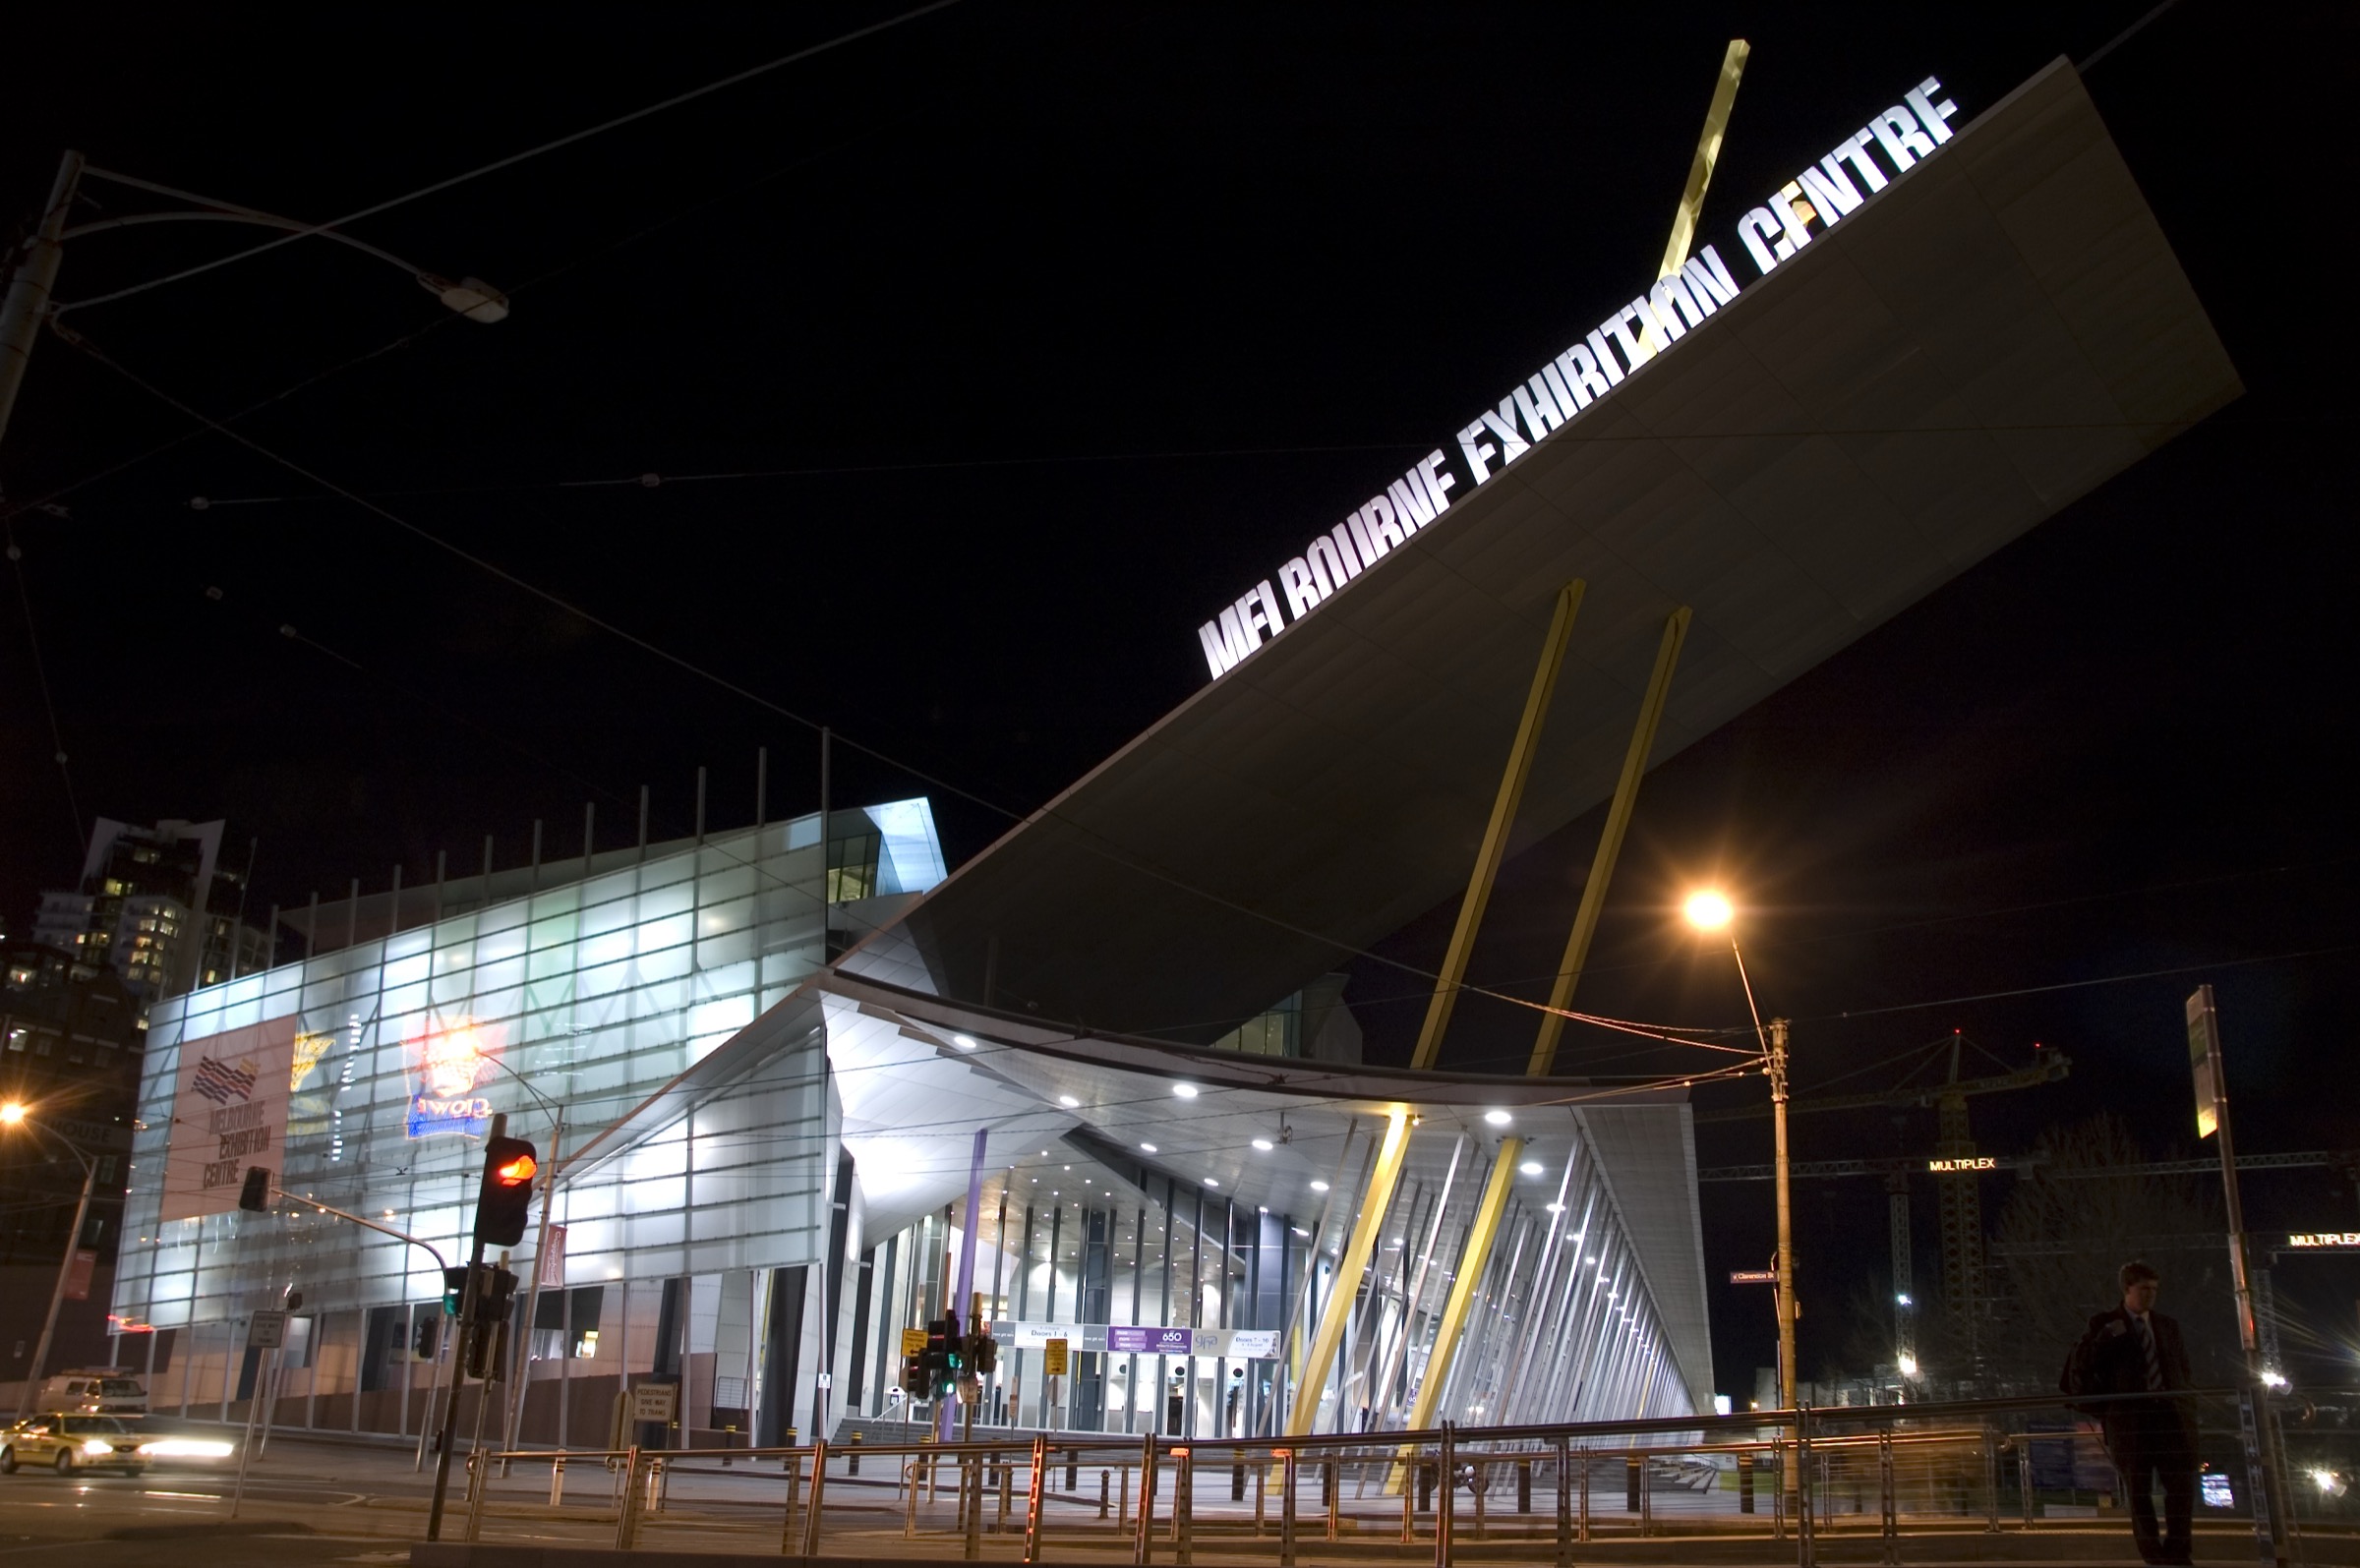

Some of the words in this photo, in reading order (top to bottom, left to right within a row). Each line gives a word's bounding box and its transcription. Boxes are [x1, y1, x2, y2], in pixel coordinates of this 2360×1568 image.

[1455, 244, 1741, 487] EXHIBITION
[1737, 75, 1958, 276] CENTRE
[208, 1100, 266, 1134] MELBOURNE
[219, 1126, 271, 1160] EXHIBITION
[204, 1158, 240, 1189] CENTRE
[1929, 1157, 1995, 1171] MULTIPLEX
[1162, 1332, 1182, 1342] 650
